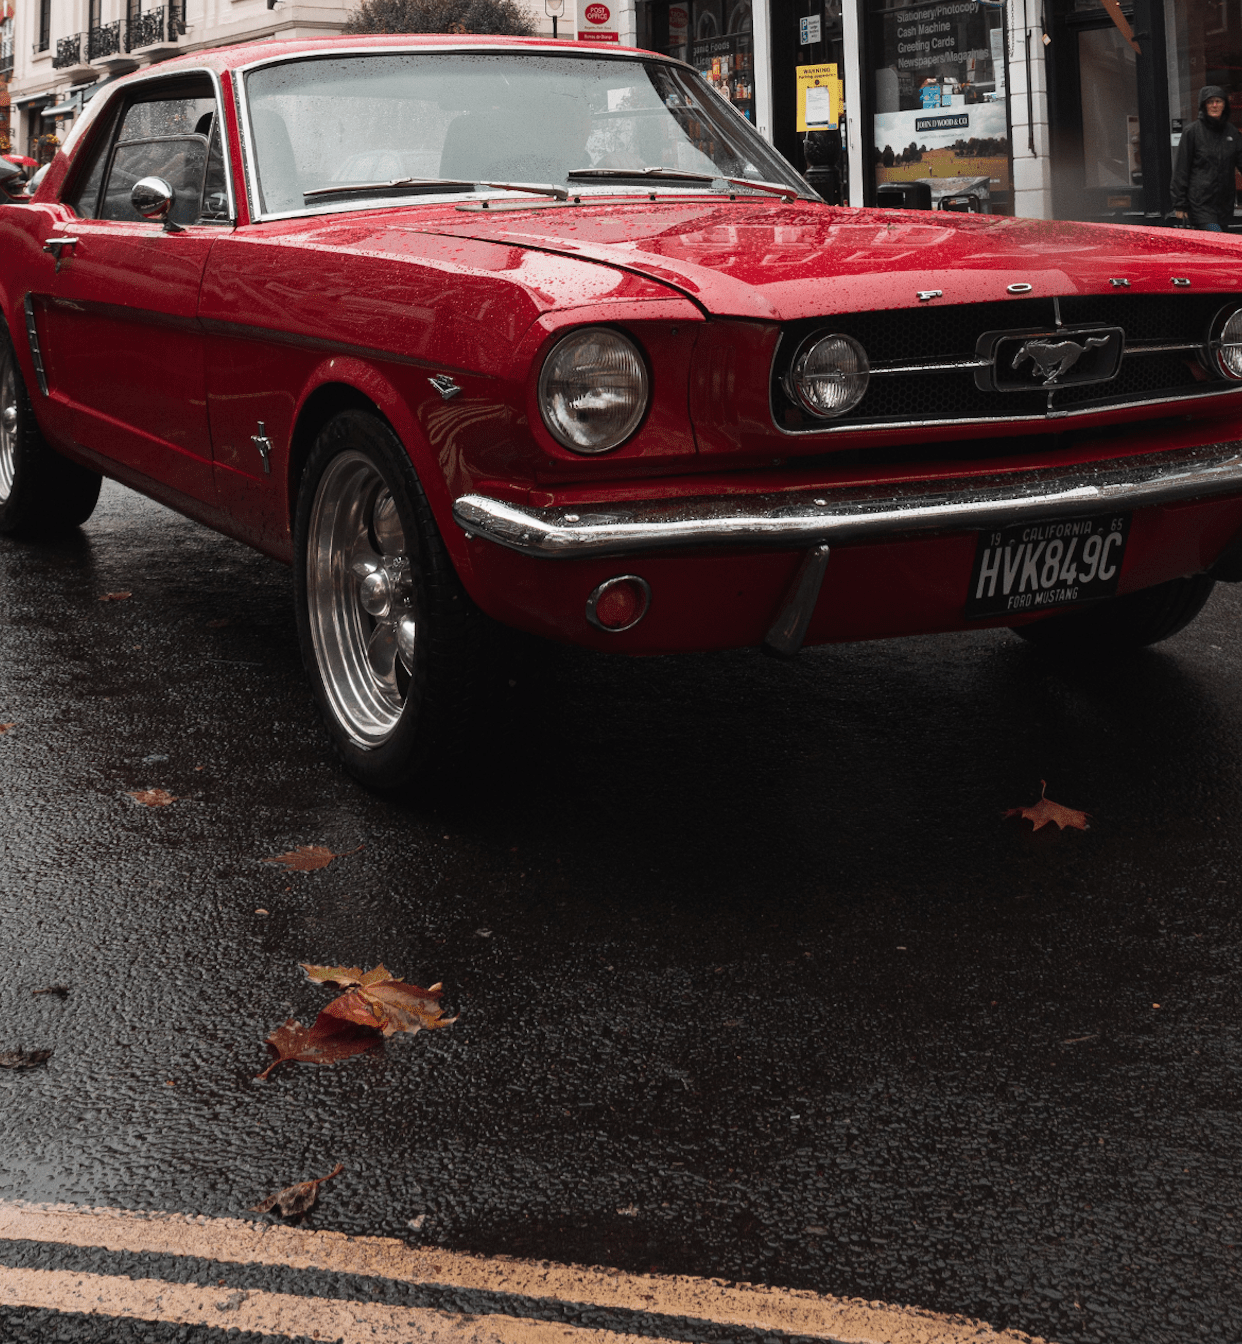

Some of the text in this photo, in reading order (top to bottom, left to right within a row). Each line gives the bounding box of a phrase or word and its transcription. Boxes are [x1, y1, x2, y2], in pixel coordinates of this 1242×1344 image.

[586, 13, 608, 21] OFFICE
[897, 2, 979, 23] Stationery/Photocopy
[897, 21, 951, 38] Cash Machine
[711, 40, 730, 52] Foods
[897, 36, 955, 53] Greeting Cards
[898, 48, 989, 69] Newspapers/Magazines
[917, 117, 968, 130] JOHN D WOOD & CO
[916, 277, 1191, 301] FORD
[991, 518, 1124, 546] 19 CALIFORNIA 65
[975, 532, 1123, 599] HVK849C
[1007, 587, 1079, 609] FORD MUSTANG
